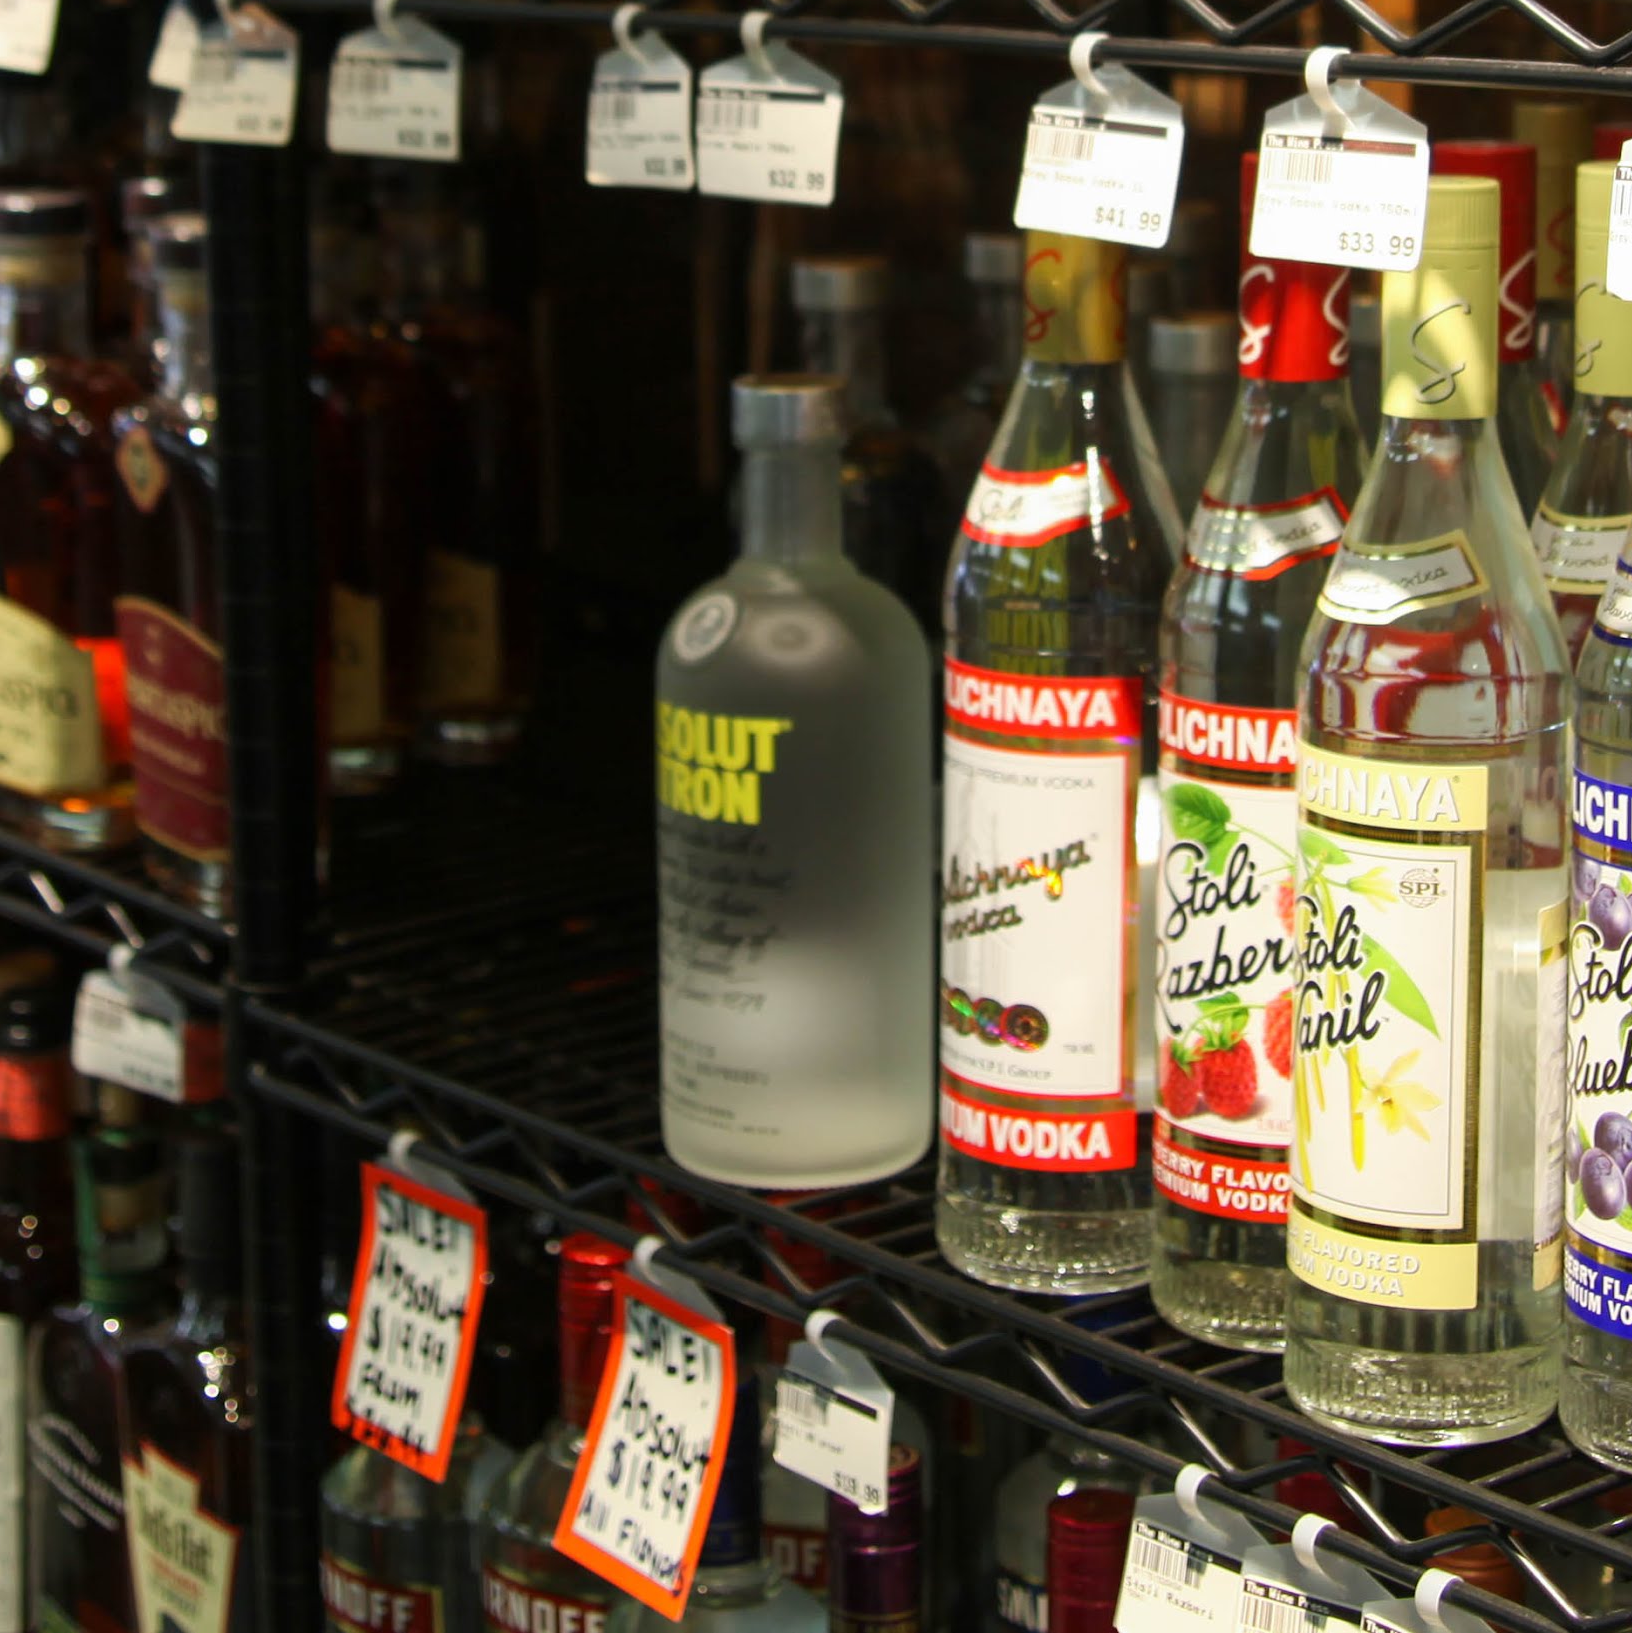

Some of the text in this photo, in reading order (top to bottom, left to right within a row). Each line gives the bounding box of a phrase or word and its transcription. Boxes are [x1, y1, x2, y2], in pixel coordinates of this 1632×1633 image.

[945, 671, 1116, 731] LICHNAYA
[658, 702, 778, 773] SOLUT
[1303, 759, 1459, 824] CHNAYA
[987, 1118, 1113, 1164] VODKA
[1211, 1164, 1291, 1193] FLAVO
[1323, 1262, 1405, 1298] VODKA
